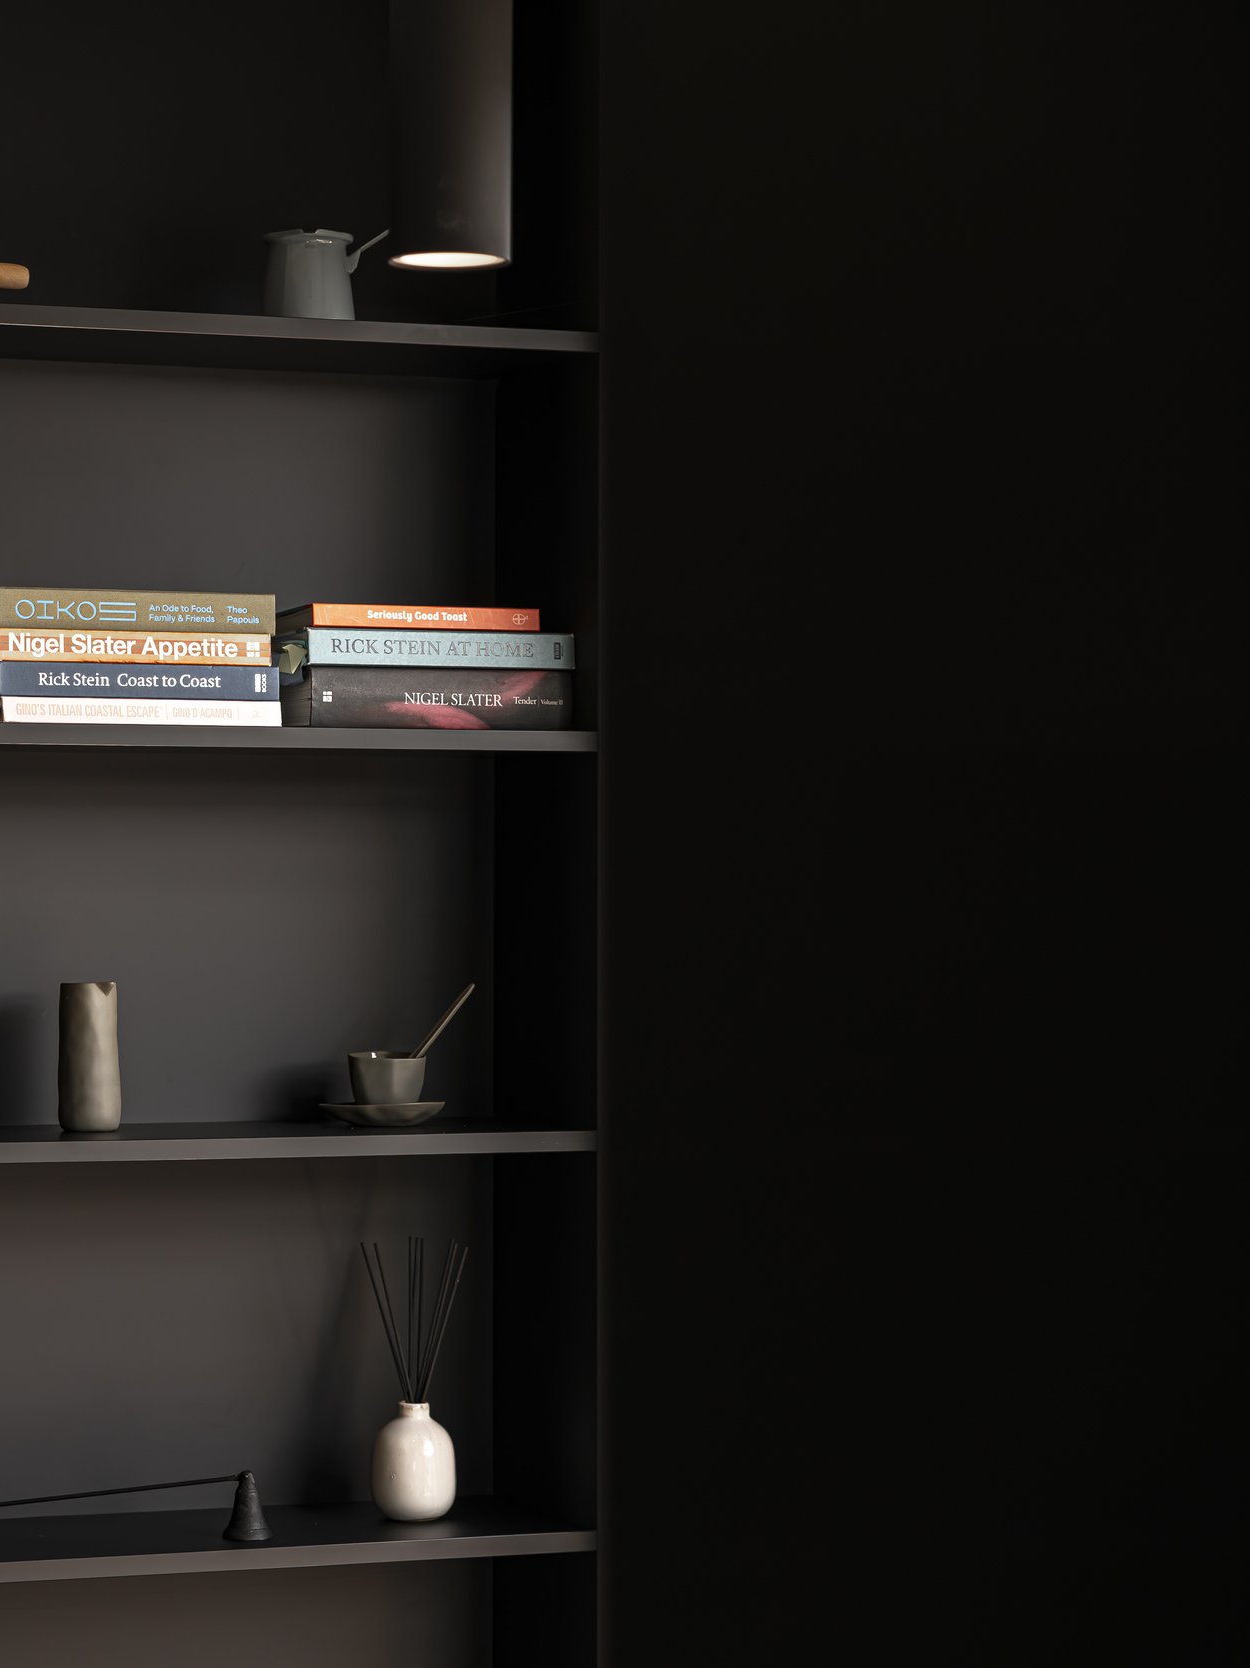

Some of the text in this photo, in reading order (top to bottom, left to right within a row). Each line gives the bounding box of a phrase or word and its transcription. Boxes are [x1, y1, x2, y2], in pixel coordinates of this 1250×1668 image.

[15, 599, 137, 622] OIKOS
[162, 605, 179, 613] Ode
[191, 605, 214, 614] Food,
[227, 606, 248, 614] Theo
[367, 610, 467, 622] Seriously Good Toast
[149, 614, 175, 624] Family
[185, 615, 215, 623] Friends
[8, 633, 238, 660] Nigel Slater Appetite
[331, 639, 534, 658] RICK STEIN AT HOME
[38, 672, 221, 688] Rick Stein Coast to Coast
[404, 692, 502, 707] NIGEL SLATER
[513, 696, 537, 705] Tender
[16, 703, 160, 718] GINO'S ITALIAN COASTAL ESCAPE
[173, 708, 232, 719] GINO D'ACAMPO
